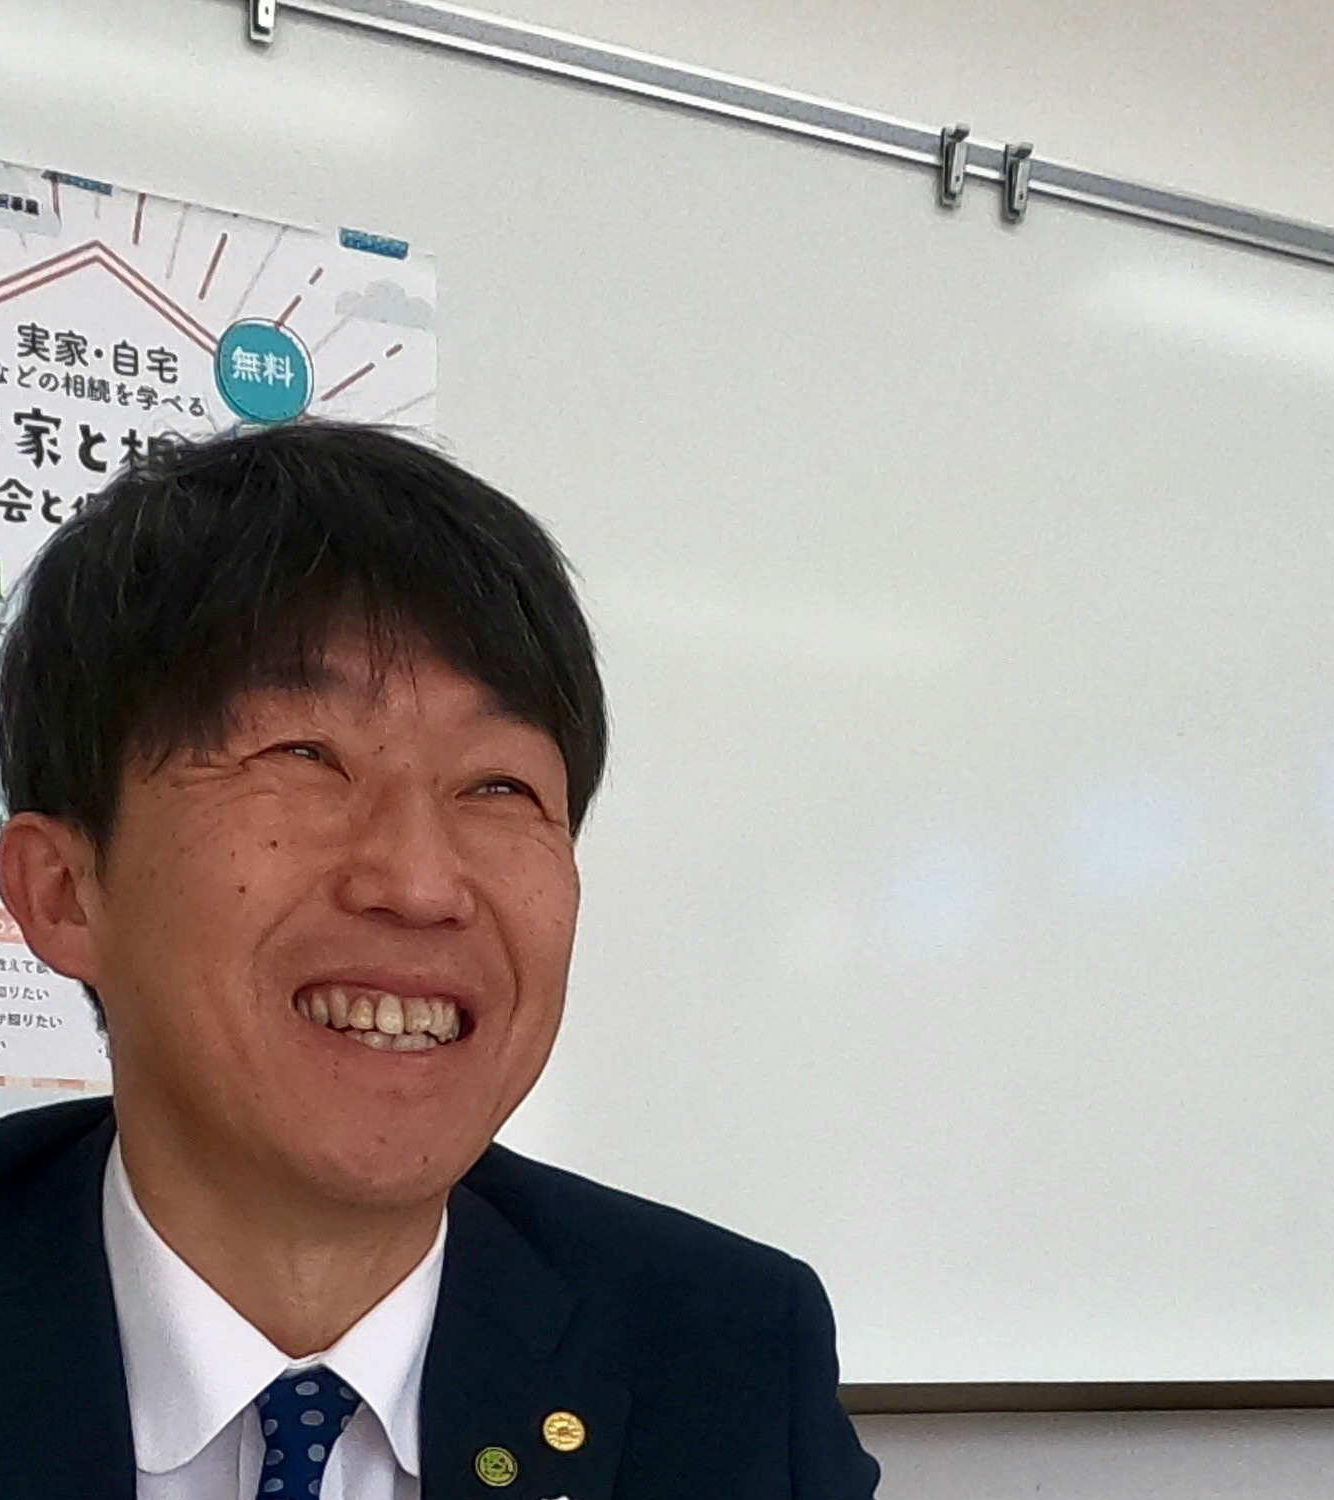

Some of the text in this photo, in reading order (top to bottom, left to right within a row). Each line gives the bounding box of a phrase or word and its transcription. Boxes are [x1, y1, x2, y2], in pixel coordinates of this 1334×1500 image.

[16, 322, 179, 385] 実家・自宅
[231, 346, 295, 388] 無料
